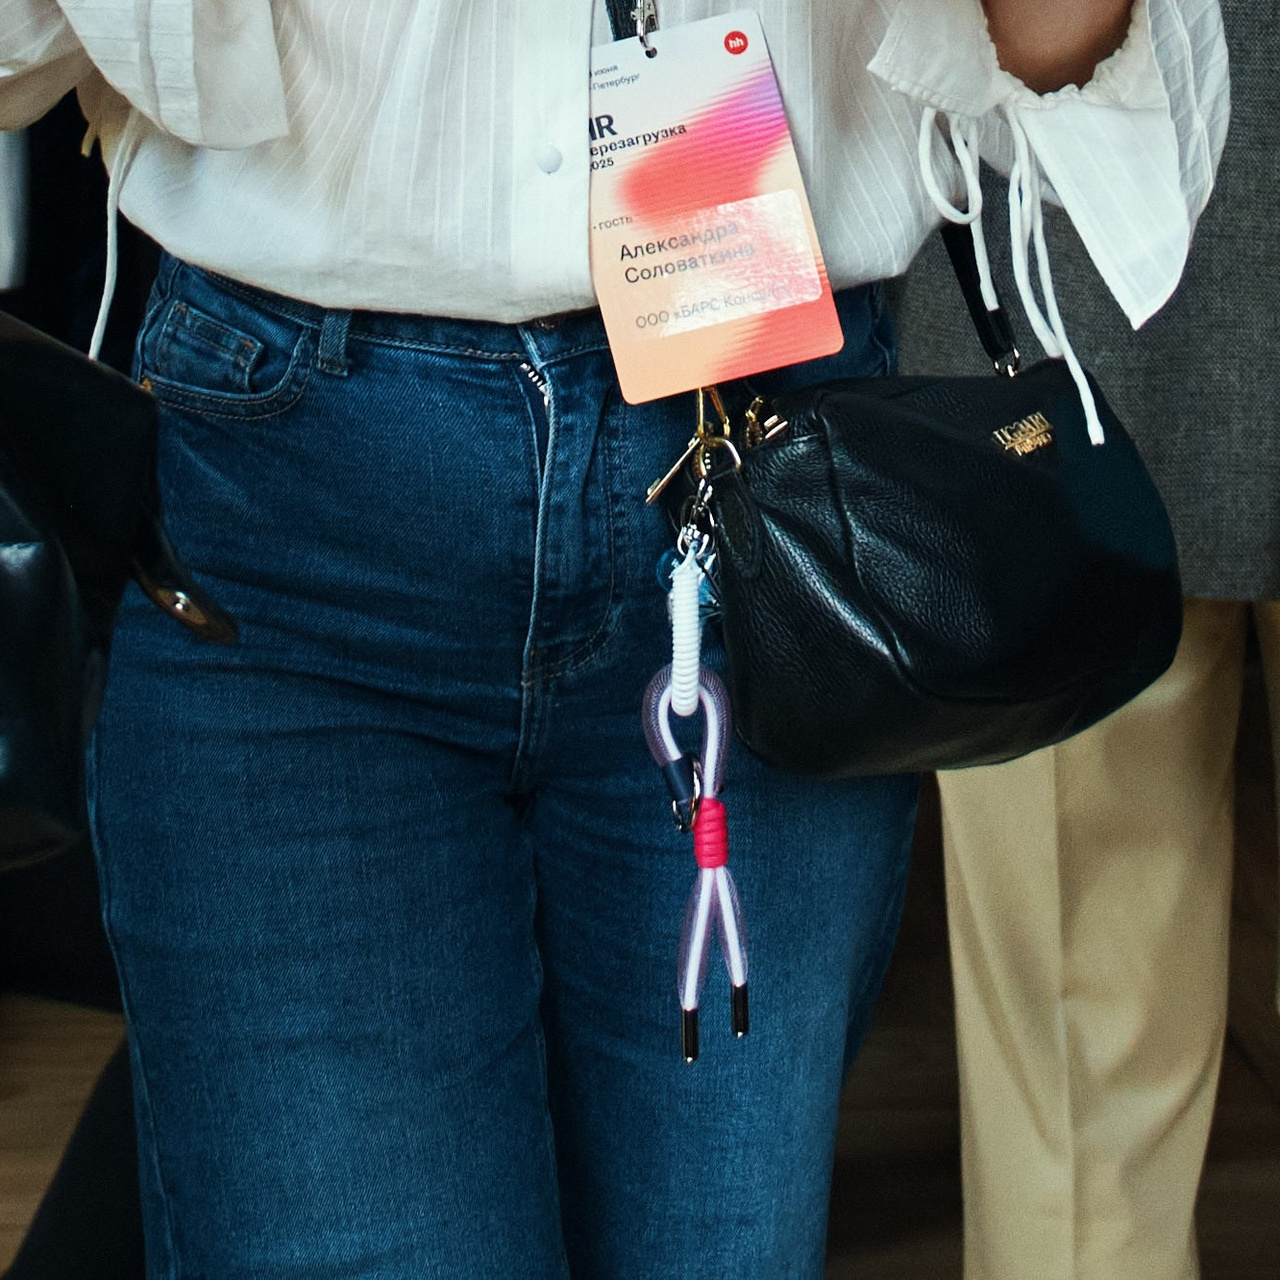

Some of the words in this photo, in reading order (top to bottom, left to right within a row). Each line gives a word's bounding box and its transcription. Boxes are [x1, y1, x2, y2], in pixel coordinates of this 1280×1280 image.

[590, 124, 687, 156] ерезагрузка
[589, 157, 615, 172] 025
[598, 215, 634, 230] гость
[620, 221, 739, 261] Александра
[635, 309, 670, 329] ООО
